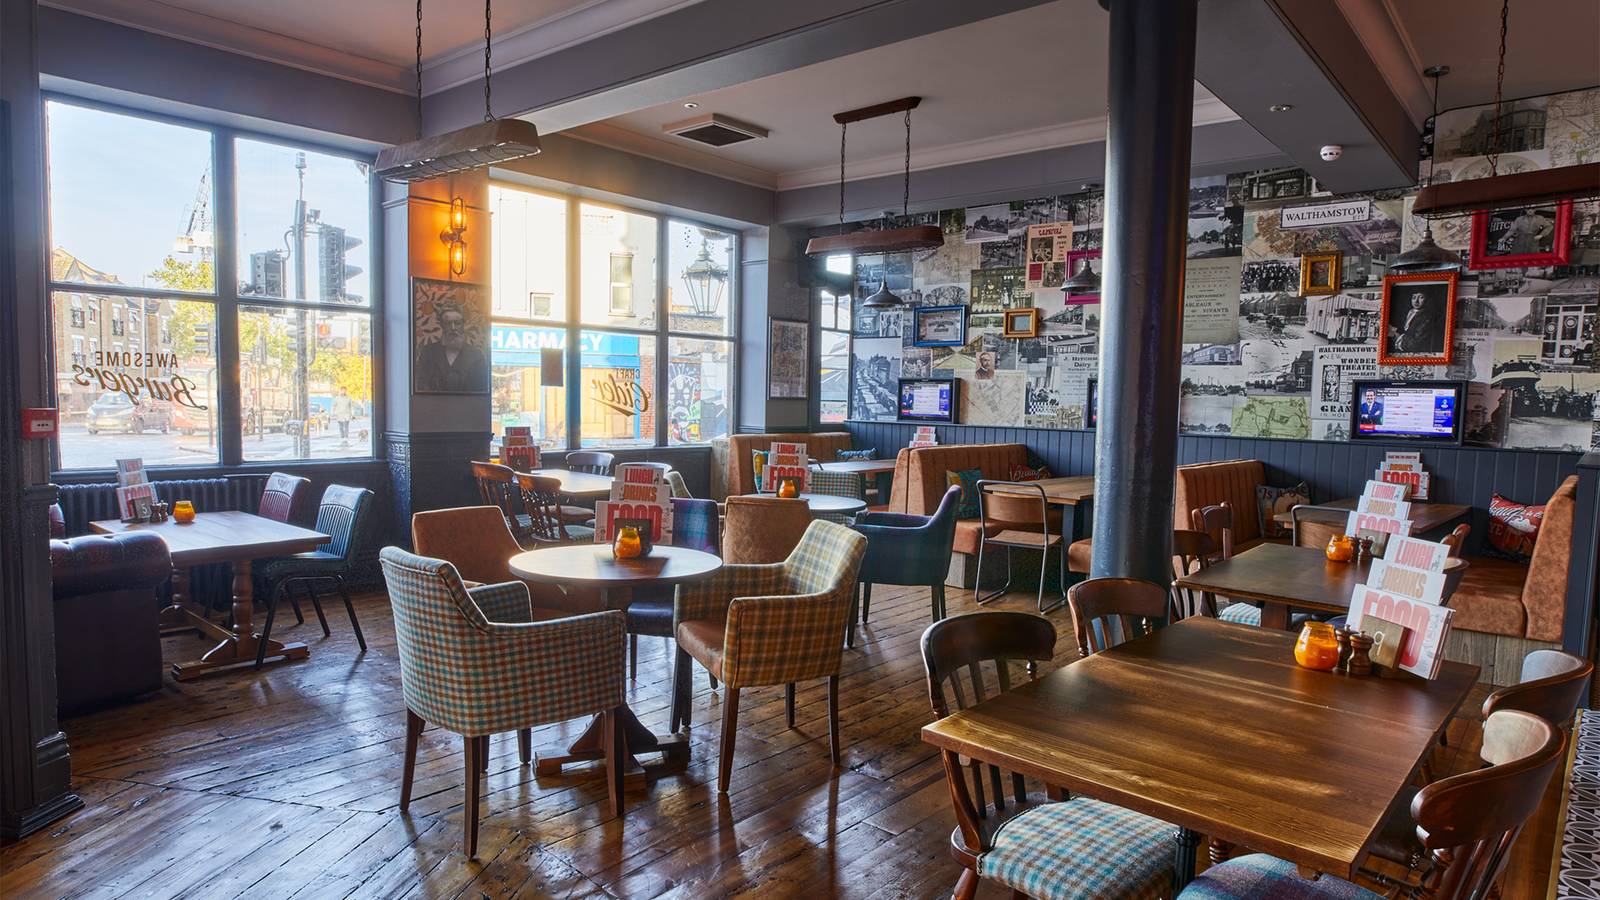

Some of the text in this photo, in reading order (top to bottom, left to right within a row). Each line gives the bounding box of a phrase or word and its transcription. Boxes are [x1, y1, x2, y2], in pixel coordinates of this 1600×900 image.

[1286, 207, 1365, 221] WALTHAMSTOW
[625, 468, 654, 484] LUNCH
[623, 484, 657, 502] DRINKS
[142, 503, 148, 514] 5
[1394, 540, 1436, 570] LUNCH
[1382, 565, 1427, 599] DRINKS
